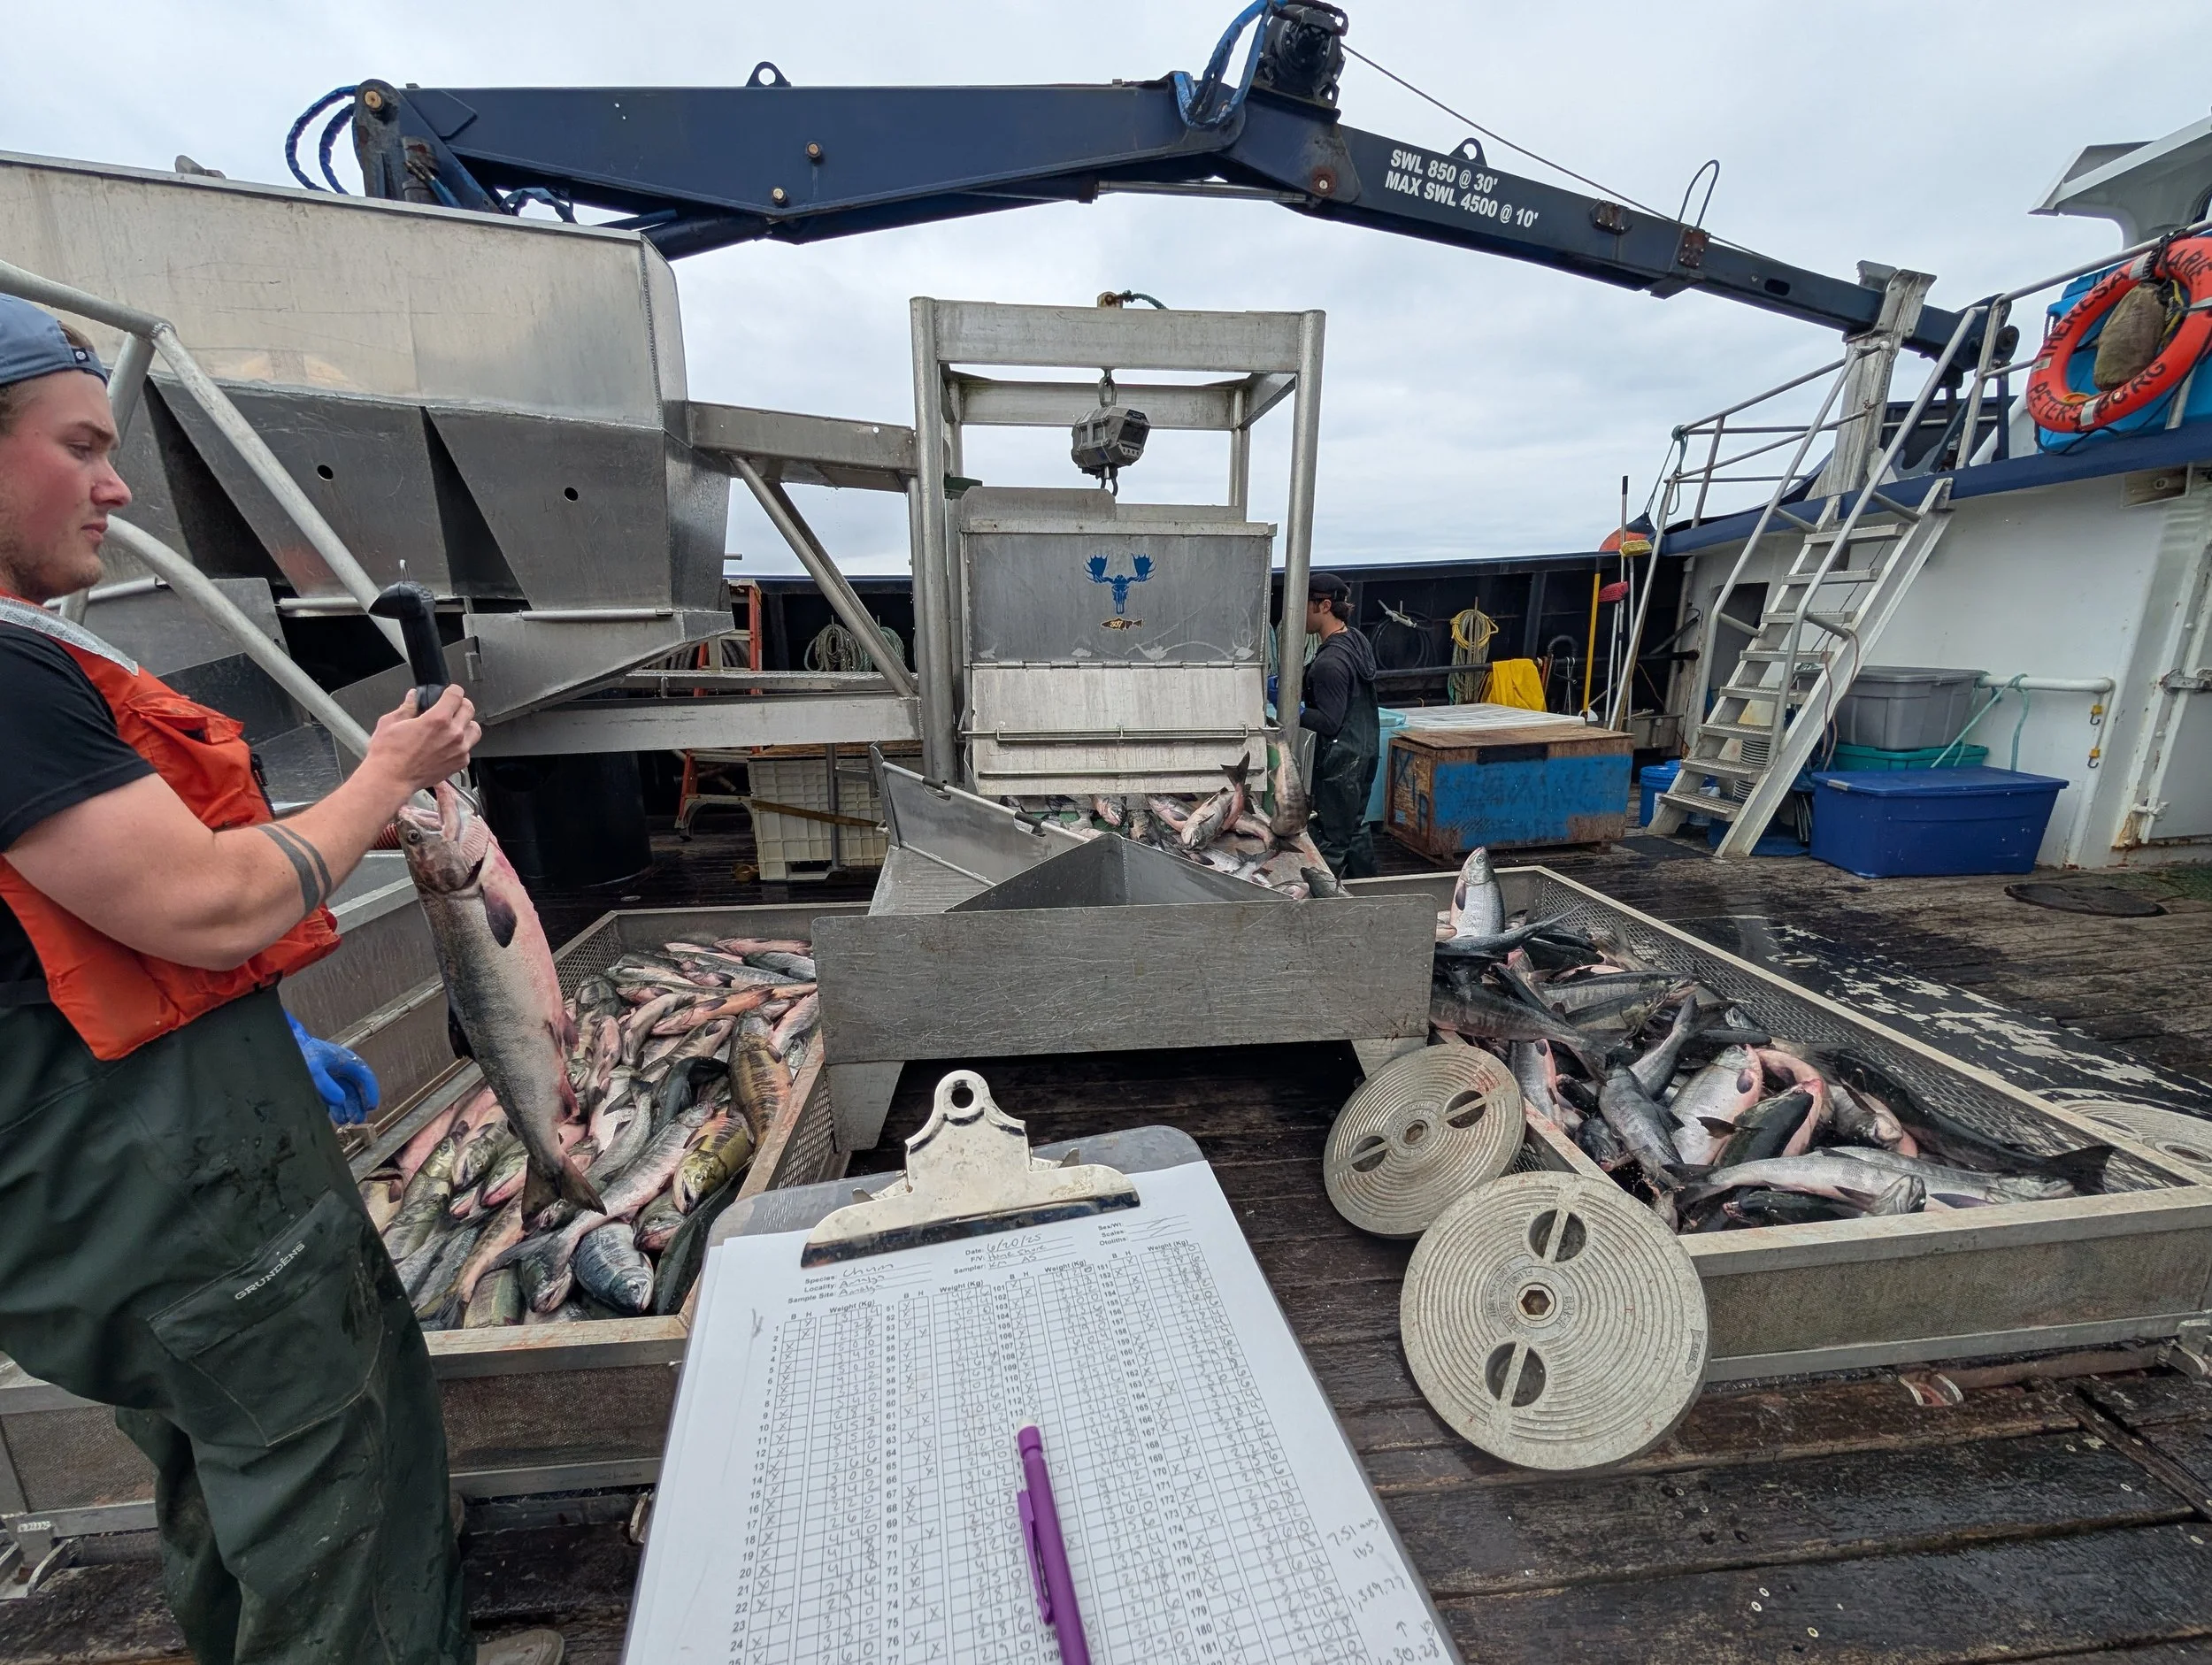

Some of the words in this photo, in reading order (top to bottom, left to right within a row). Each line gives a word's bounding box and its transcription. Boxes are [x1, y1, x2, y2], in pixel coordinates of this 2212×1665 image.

[1390, 149, 1424, 175] SWL
[1427, 159, 1457, 183] 850
[1458, 169, 1471, 189] @
[1473, 173, 1498, 194] 30'
[1385, 170, 1423, 197] MAX
[1424, 181, 1456, 207] SWL
[1460, 192, 1498, 218] 4500
[1500, 203, 1512, 224] @
[1516, 207, 1539, 228] 10'
[1147, 1242, 1172, 1252] Weight
[1173, 1239, 1189, 1248] (Kg)
[954, 1263, 986, 1274] Sampler:
[1044, 1262, 1071, 1274] Weight
[1071, 1259, 1087, 1269] (Kg)
[804, 1275, 837, 1285] Species:
[803, 1283, 837, 1293] Locality:
[940, 1283, 967, 1293] Weight
[967, 1279, 984, 1289] (Kg)
[787, 1294, 817, 1304] Sample
[829, 1303, 856, 1314] Weight
[858, 1299, 875, 1309] (Kg)
[1004, 1363, 1017, 1372] 109
[1133, 1392, 1145, 1400] 164
[1010, 1408, 1023, 1417] 113
[1136, 1403, 1148, 1412] 165
[1140, 1416, 1152, 1424] 166
[1142, 1428, 1155, 1437] 167
[1146, 1440, 1159, 1449] 168
[1149, 1454, 1163, 1463] 169
[755, 1462, 764, 1471] 13
[887, 1462, 896, 1470] 65
[1153, 1467, 1166, 1477] 170
[887, 1476, 896, 1485] 66
[1156, 1481, 1171, 1491] 171
[751, 1490, 761, 1500] 15
[887, 1489, 896, 1499] 67
[1161, 1495, 1175, 1506] 172
[749, 1505, 758, 1514] 16
[887, 1504, 897, 1513] 68
[1165, 1509, 1179, 1521] 173
[747, 1520, 757, 1529] 17
[887, 1518, 897, 1528] 69
[1169, 1524, 1183, 1536] 174
[745, 1535, 756, 1545] 18
[887, 1534, 897, 1545] 70
[1173, 1538, 1187, 1550] 175
[743, 1551, 754, 1561] 19
[887, 1550, 896, 1561] 71
[1178, 1554, 1192, 1568] 176
[741, 1568, 751, 1578] 20
[887, 1566, 897, 1577] 72
[1182, 1571, 1195, 1584] 177
[737, 1585, 749, 1596] 21
[887, 1582, 898, 1592] 73
[1187, 1587, 1202, 1600] 178
[735, 1602, 748, 1614] 22
[887, 1600, 898, 1611] 74
[1191, 1605, 1207, 1618] 179
[733, 1620, 745, 1632] 23
[887, 1617, 898, 1630] 75
[1196, 1623, 1212, 1636] 180
[730, 1639, 743, 1652] 24
[887, 1635, 899, 1648] 76
[1201, 1641, 1217, 1655] 181
